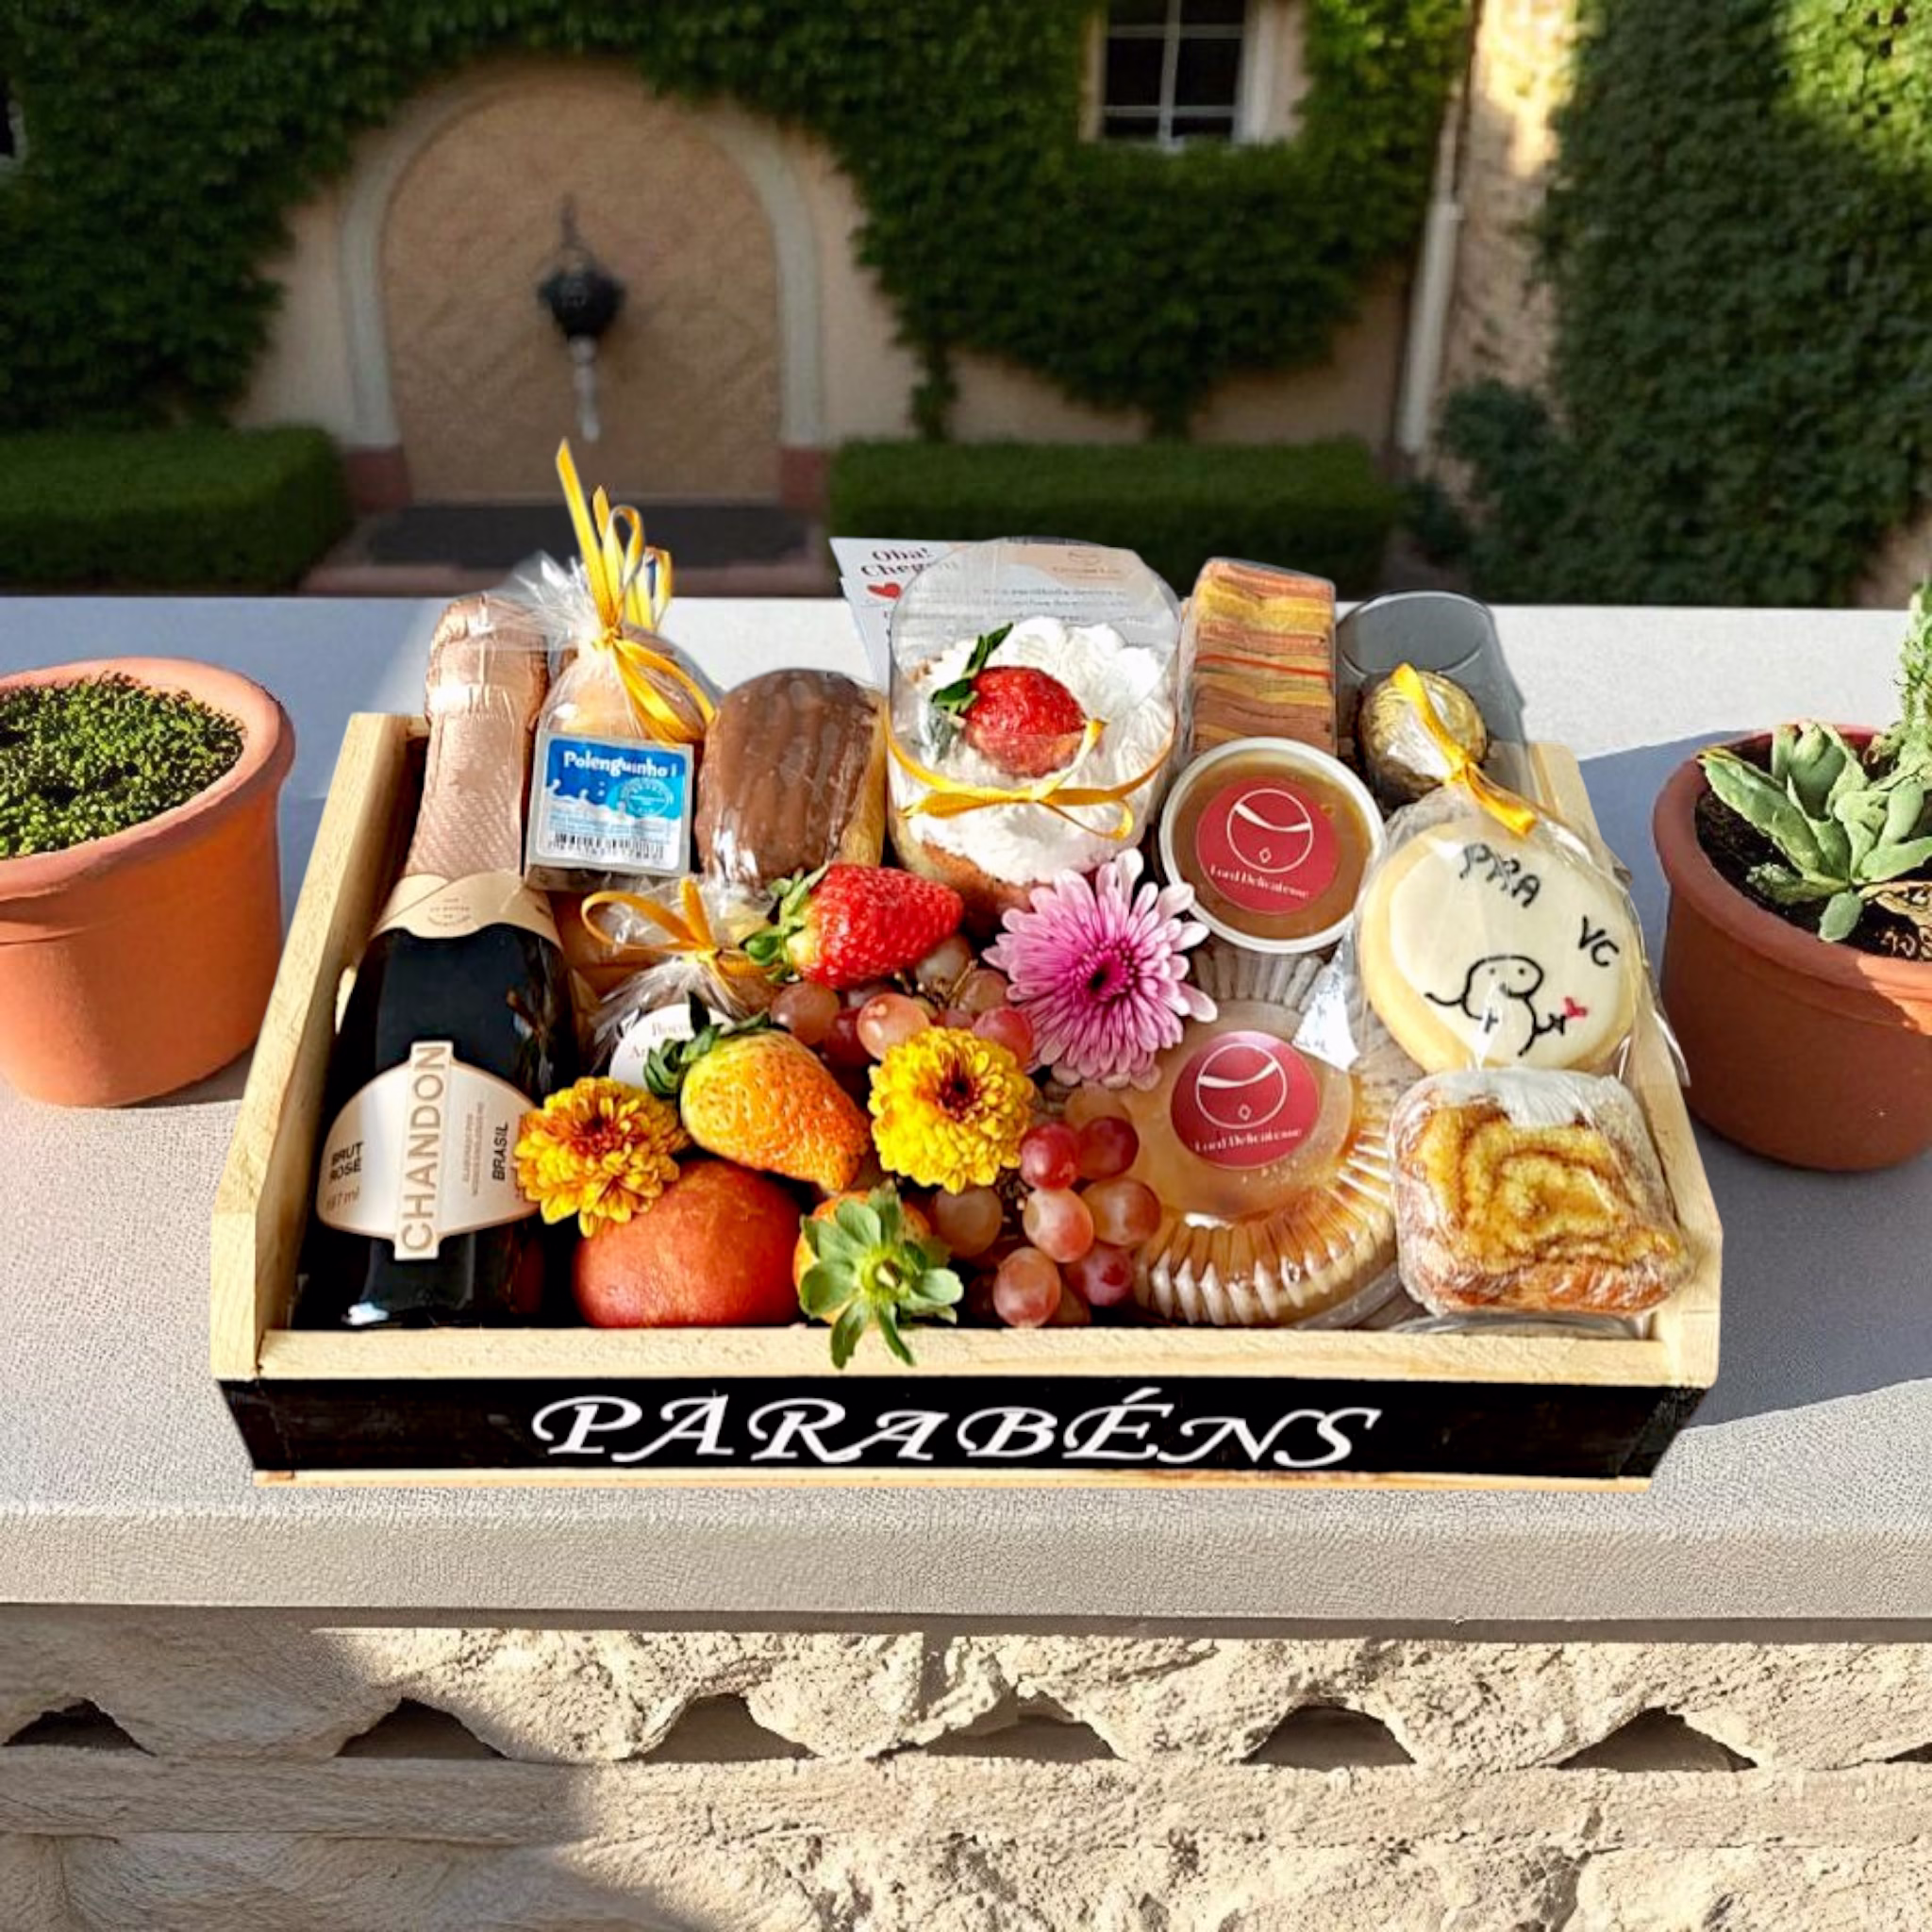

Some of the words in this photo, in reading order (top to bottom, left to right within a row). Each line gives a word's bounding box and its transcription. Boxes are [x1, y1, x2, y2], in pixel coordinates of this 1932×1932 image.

[563, 750, 669, 777] Polenguinho
[1459, 842, 1541, 908] PRA
[1577, 914, 1620, 968] VC
[331, 1141, 364, 1167] BRUT
[400, 1045, 447, 1252] CHANDON
[491, 1122, 509, 1181] BRASIL
[531, 1388, 1382, 1465] PARABÉNS
